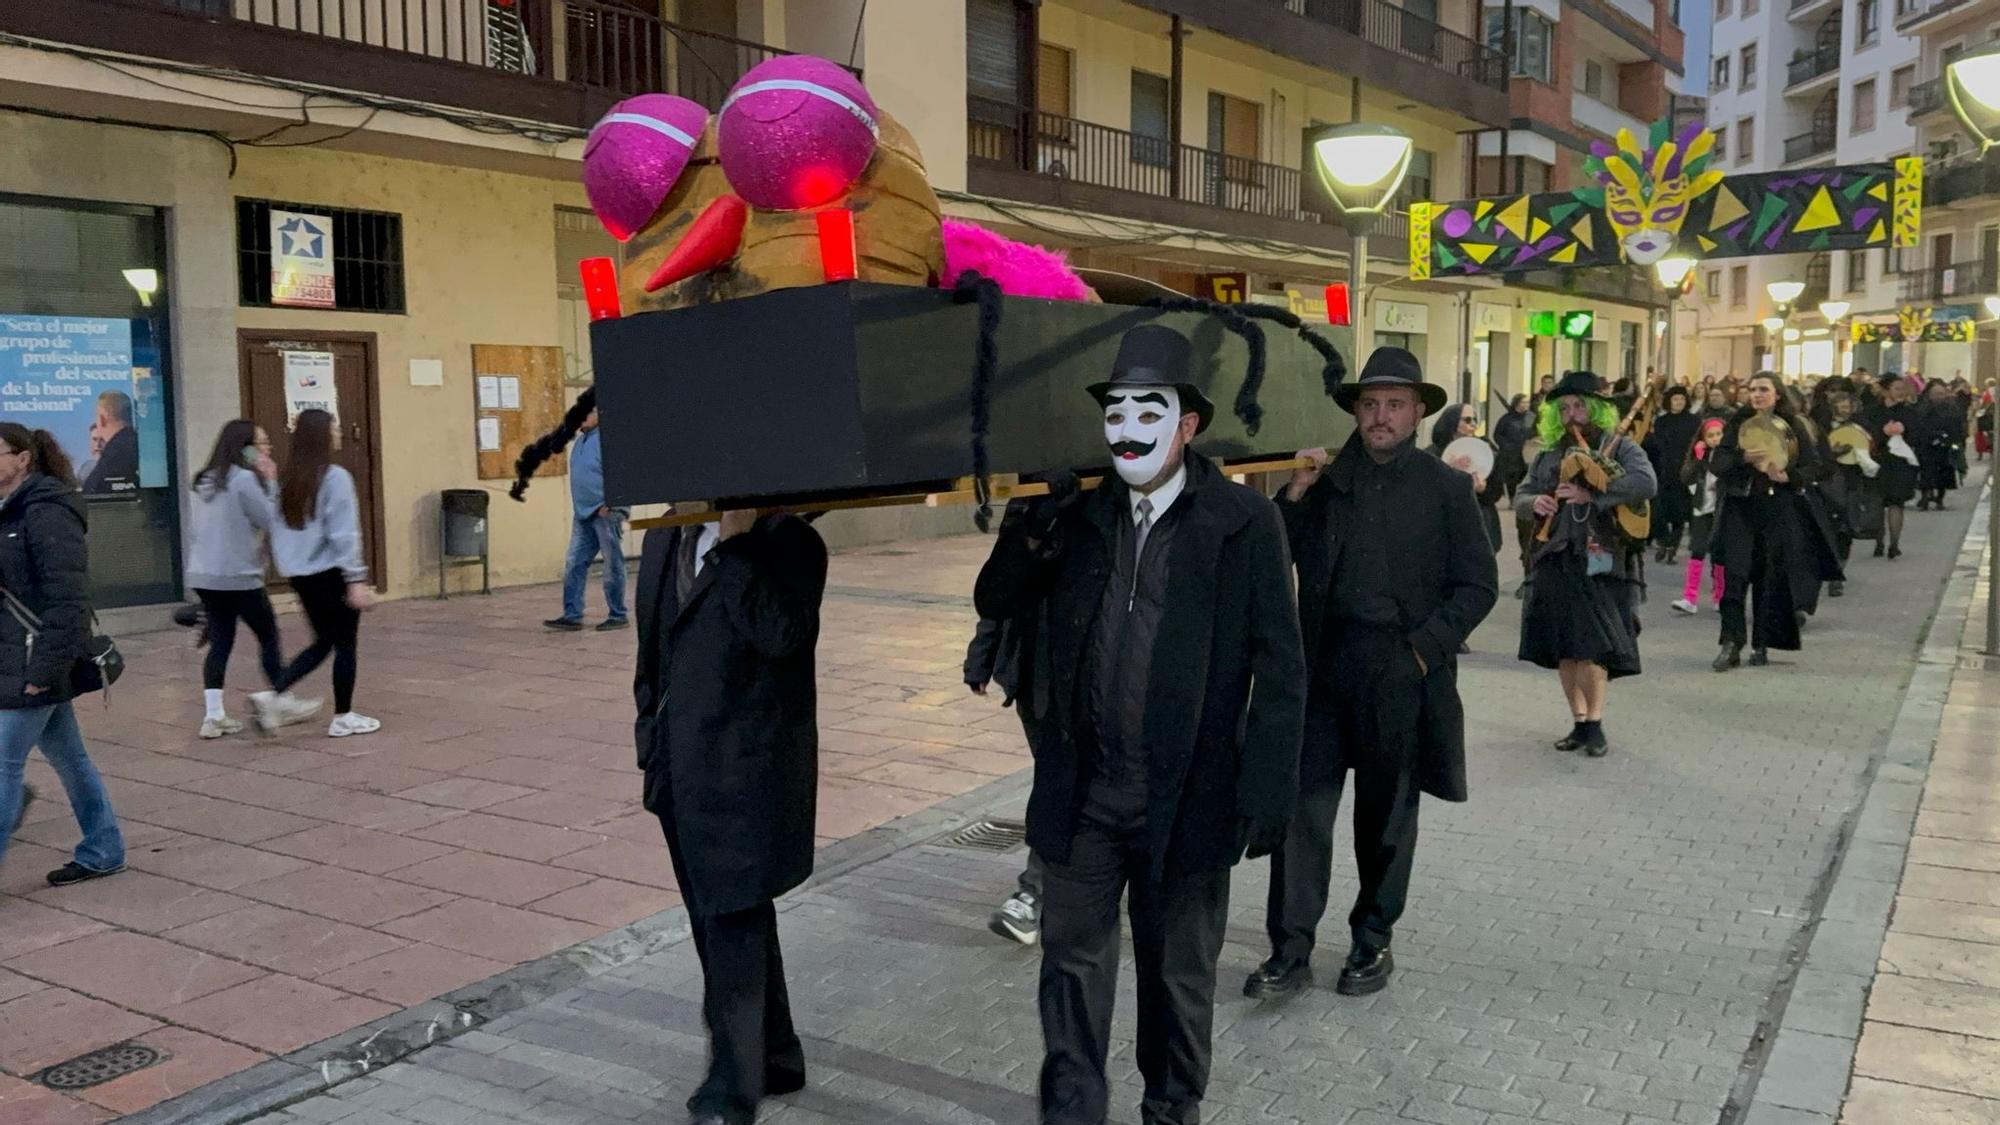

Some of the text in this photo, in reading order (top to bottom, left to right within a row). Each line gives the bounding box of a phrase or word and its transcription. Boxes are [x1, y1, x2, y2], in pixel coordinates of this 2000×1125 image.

[46, 318, 60, 332] el
[64, 320, 108, 335] mejor
[0, 337, 49, 351] grupo
[52, 335, 72, 348] de
[22, 351, 129, 367] profesionales
[55, 366, 129, 380] del sector
[2, 382, 91, 396] de la banca
